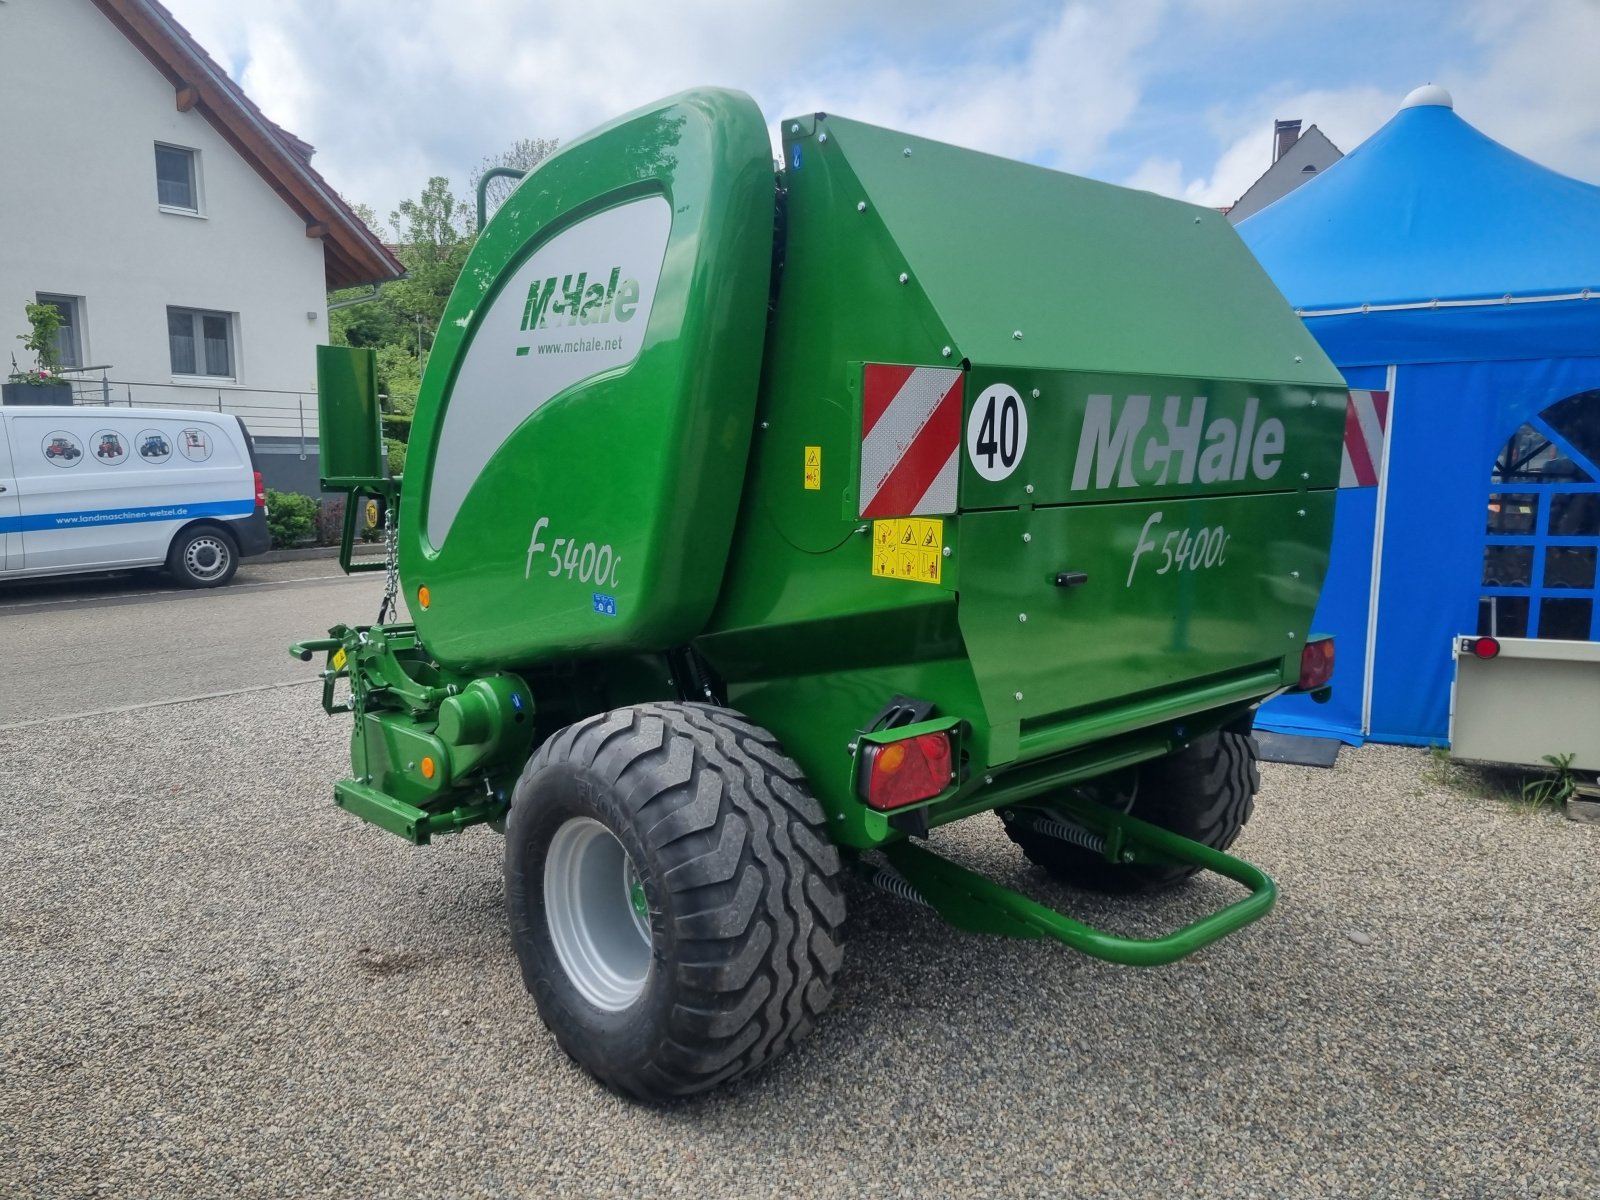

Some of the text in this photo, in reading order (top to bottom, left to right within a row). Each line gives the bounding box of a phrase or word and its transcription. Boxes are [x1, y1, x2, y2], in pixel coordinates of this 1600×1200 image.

[520, 266, 639, 332] McHale
[537, 336, 623, 355] www.mchale.net
[976, 396, 1019, 469] 40
[1071, 394, 1286, 491] McHale
[56, 508, 188, 524] www.landmaschinen-wetzel.de
